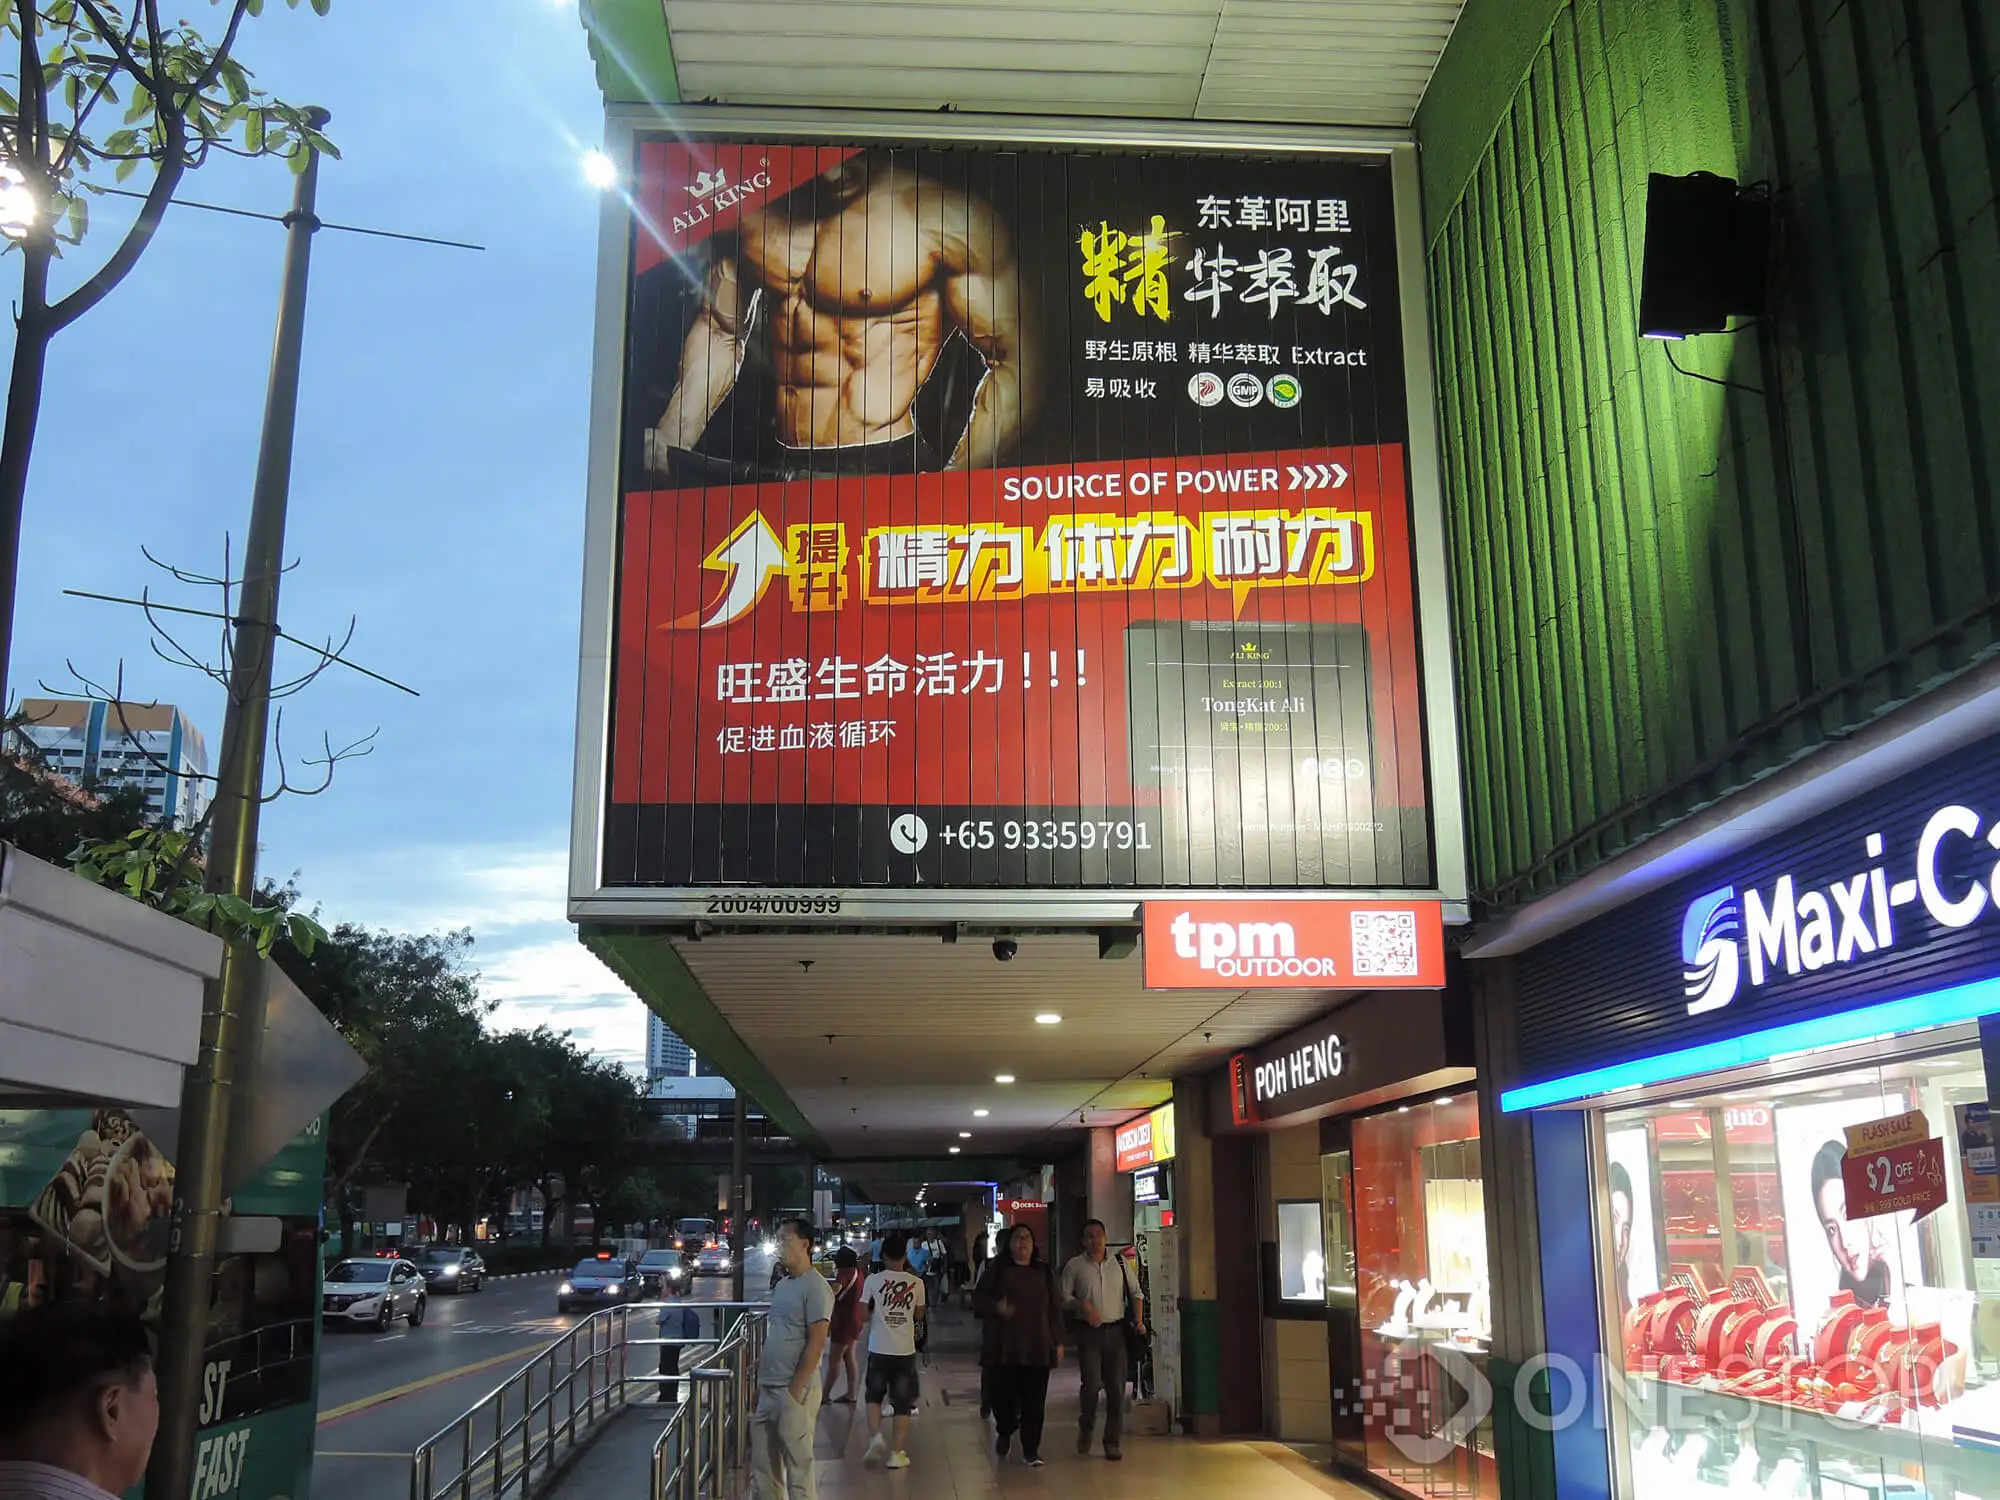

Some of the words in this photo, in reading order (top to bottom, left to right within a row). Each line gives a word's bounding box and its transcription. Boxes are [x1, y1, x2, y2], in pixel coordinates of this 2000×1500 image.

[671, 203, 710, 234] ALI
[711, 171, 772, 212] KING
[1196, 194, 1352, 233] 东革阿里
[1077, 215, 1368, 323] 精华萃取
[1084, 340, 1178, 364] 野生原根
[1188, 342, 1280, 366] 精华萃取
[1292, 347, 1367, 366] Extract
[1084, 378, 1157, 400] 易吸收
[1232, 384, 1258, 396] GMP
[1003, 473, 1122, 501] SOURCE
[1129, 472, 1168, 496] OF
[1176, 468, 1279, 494] POWER
[876, 527, 1025, 591] 精力
[1046, 518, 1190, 583] 体力
[1210, 513, 1356, 578] 耐力
[1223, 679, 1256, 688] Exract
[1201, 697, 1276, 717] TongKat
[1281, 697, 1306, 713] Ali
[716, 720, 897, 754] 促进血液循环
[938, 820, 995, 850] +65
[1003, 820, 1152, 850] 93359791
[707, 895, 841, 914] 2004/00999
[1743, 804, 2000, 986] Maxi-C
[1171, 912, 1295, 969] tpm
[1217, 958, 1336, 977] OUTDOOR
[1255, 1056, 1287, 1101] POH
[1290, 1034, 1342, 1089] HENG
[1862, 1120, 1891, 1142] FLASH
[1891, 1115, 1912, 1135] SALE
[1866, 1156, 1895, 1194] $2
[1895, 1161, 1914, 1178] OFF
[190, 1428, 251, 1500] FAST
